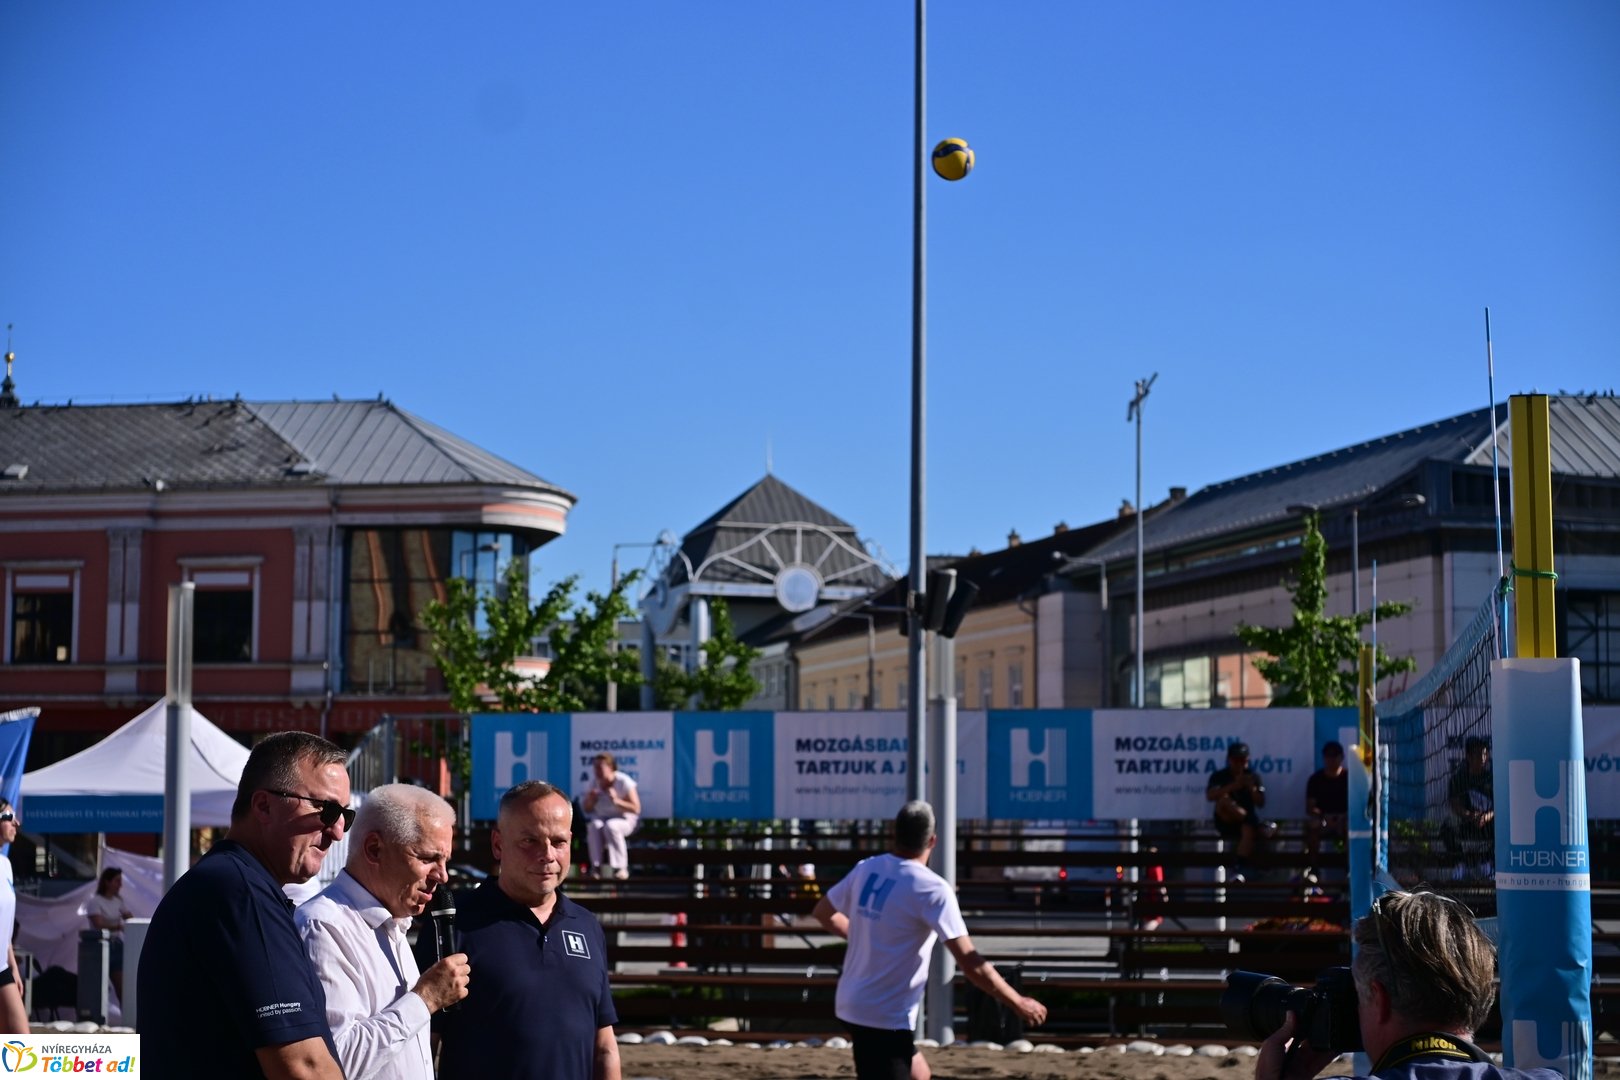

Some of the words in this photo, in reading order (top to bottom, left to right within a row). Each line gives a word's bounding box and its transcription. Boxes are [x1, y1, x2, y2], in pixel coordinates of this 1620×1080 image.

[580, 739, 664, 751] MOZGÁSBAN
[795, 760, 876, 775] TARTJUK
[881, 760, 894, 775] A
[1115, 759, 1199, 774] TARTJUK
[1204, 759, 1217, 774] A
[1510, 850, 1586, 867] HÜBNER
